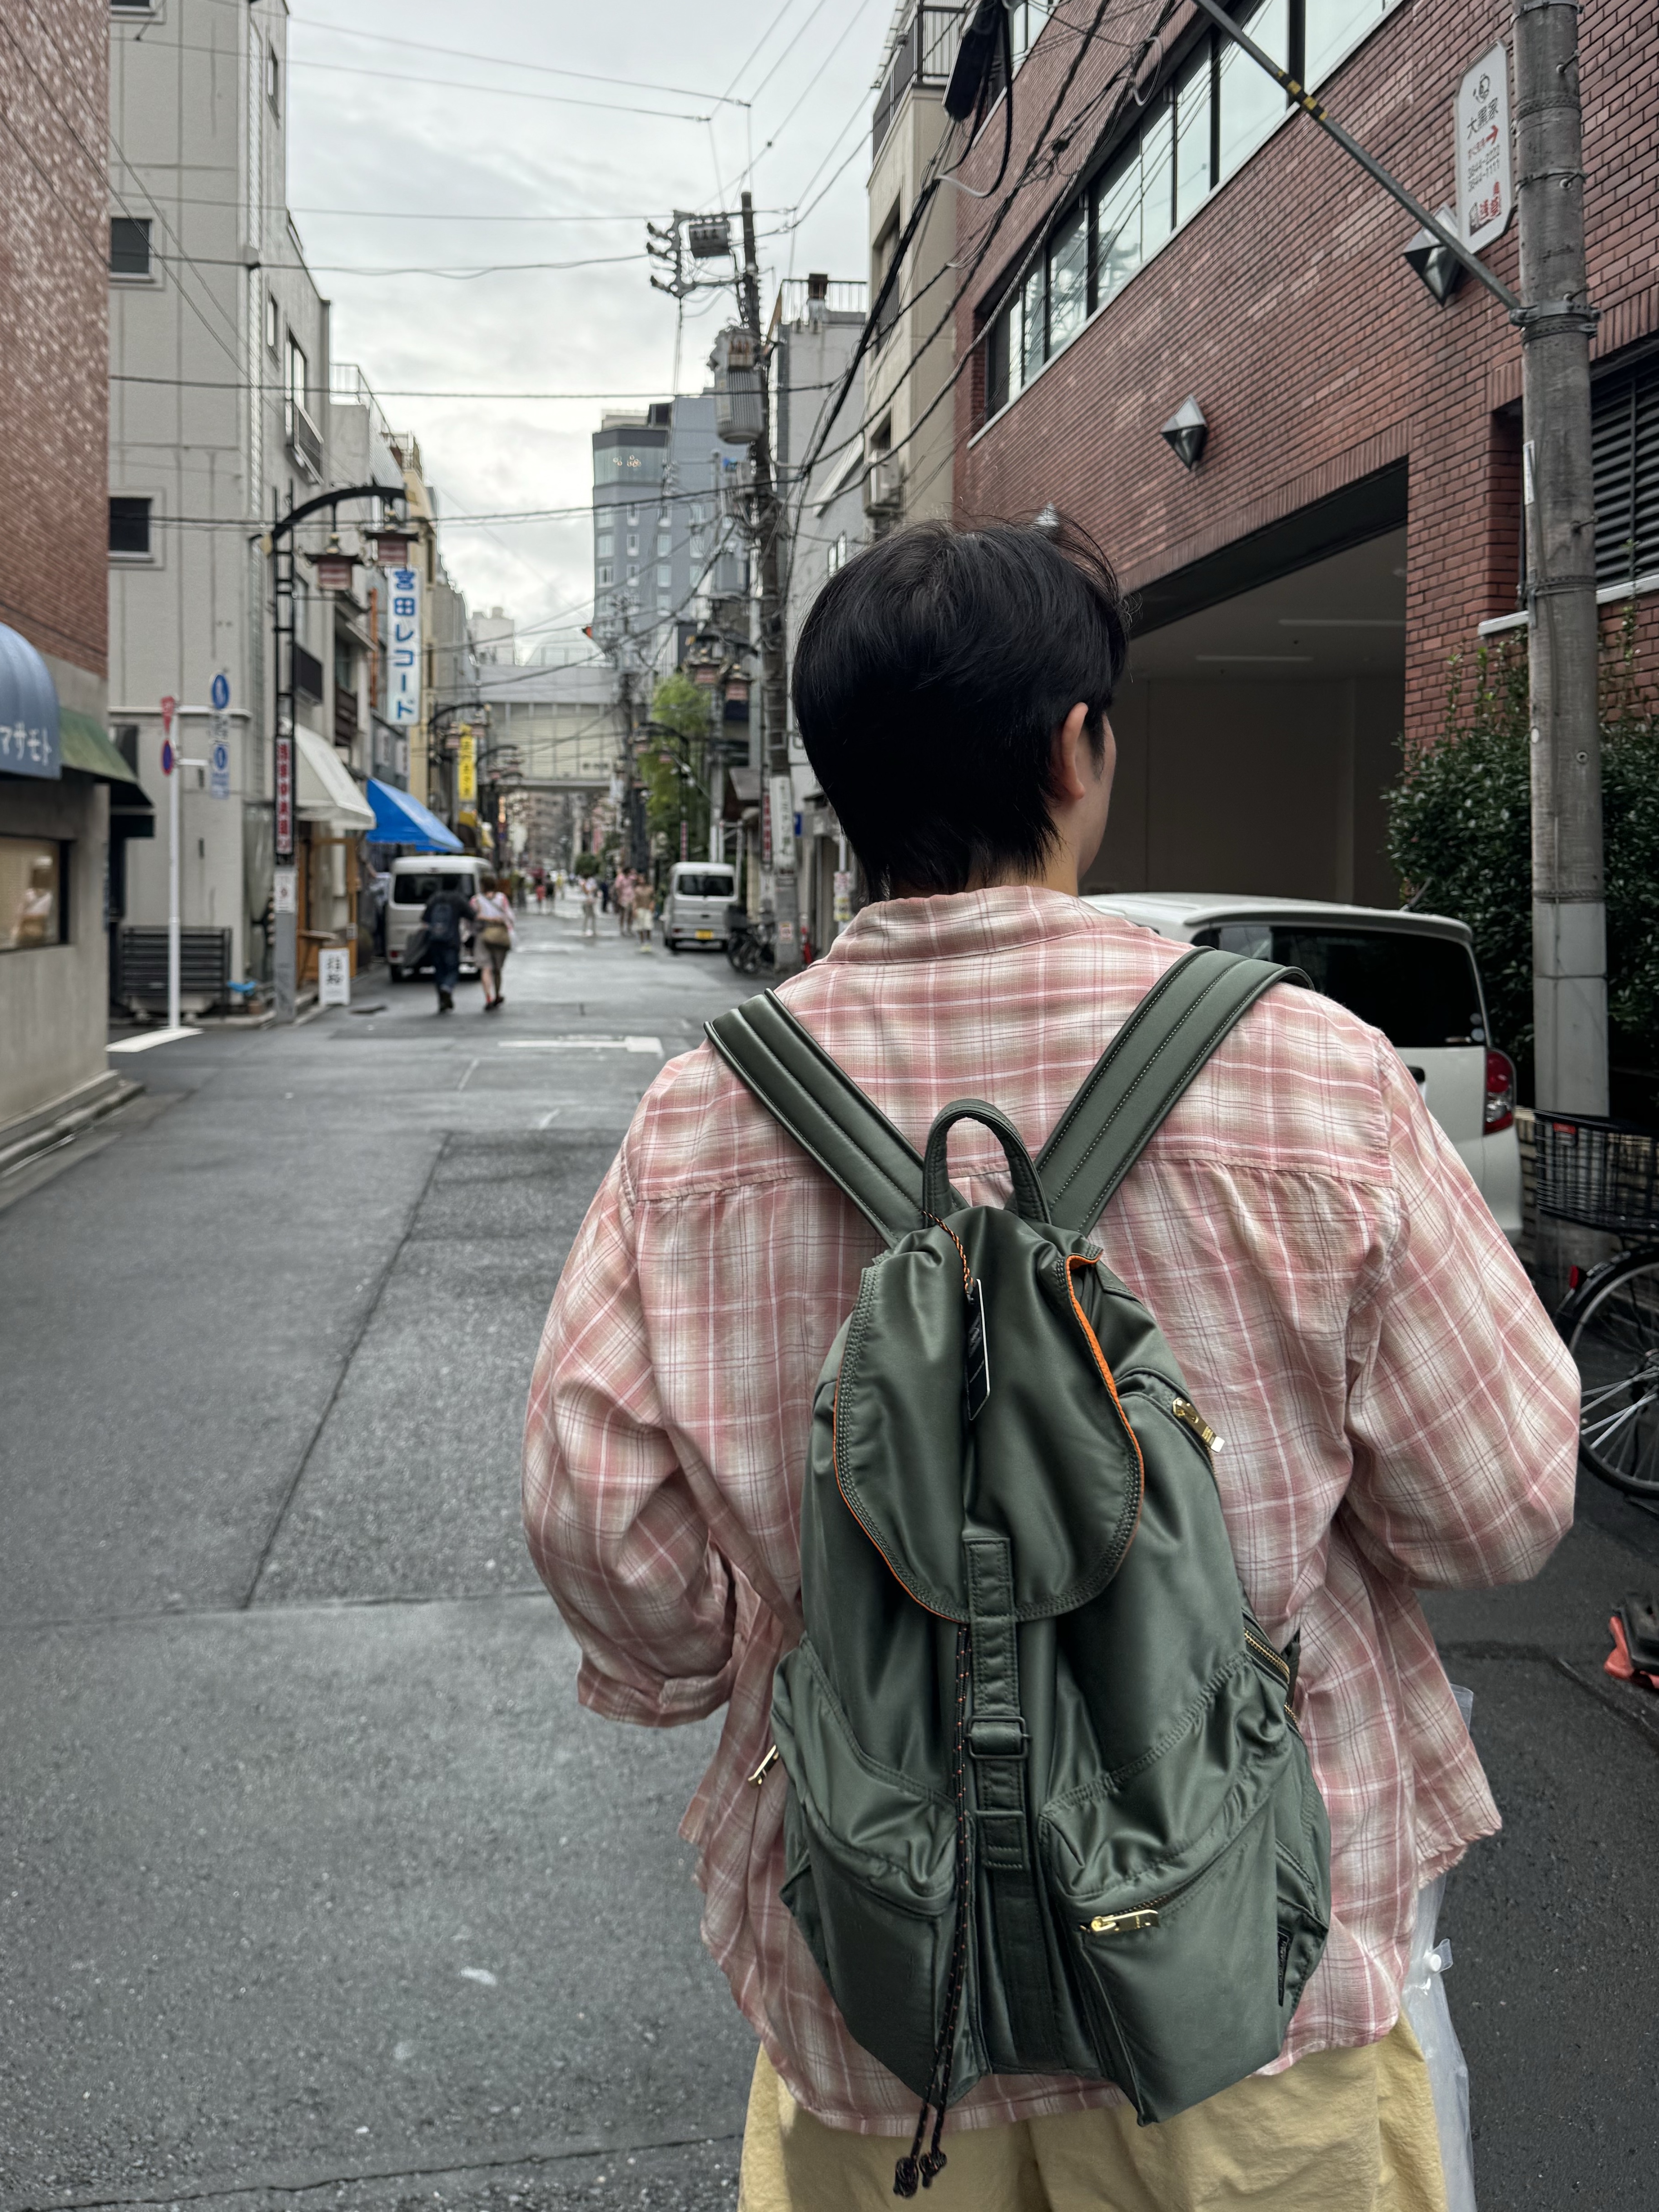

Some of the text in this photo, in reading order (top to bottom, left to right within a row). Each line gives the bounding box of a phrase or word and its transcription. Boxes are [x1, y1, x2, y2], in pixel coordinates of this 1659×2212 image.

[1467, 97, 1499, 140] 大黒家
[394, 570, 416, 720] 宮田レコード
